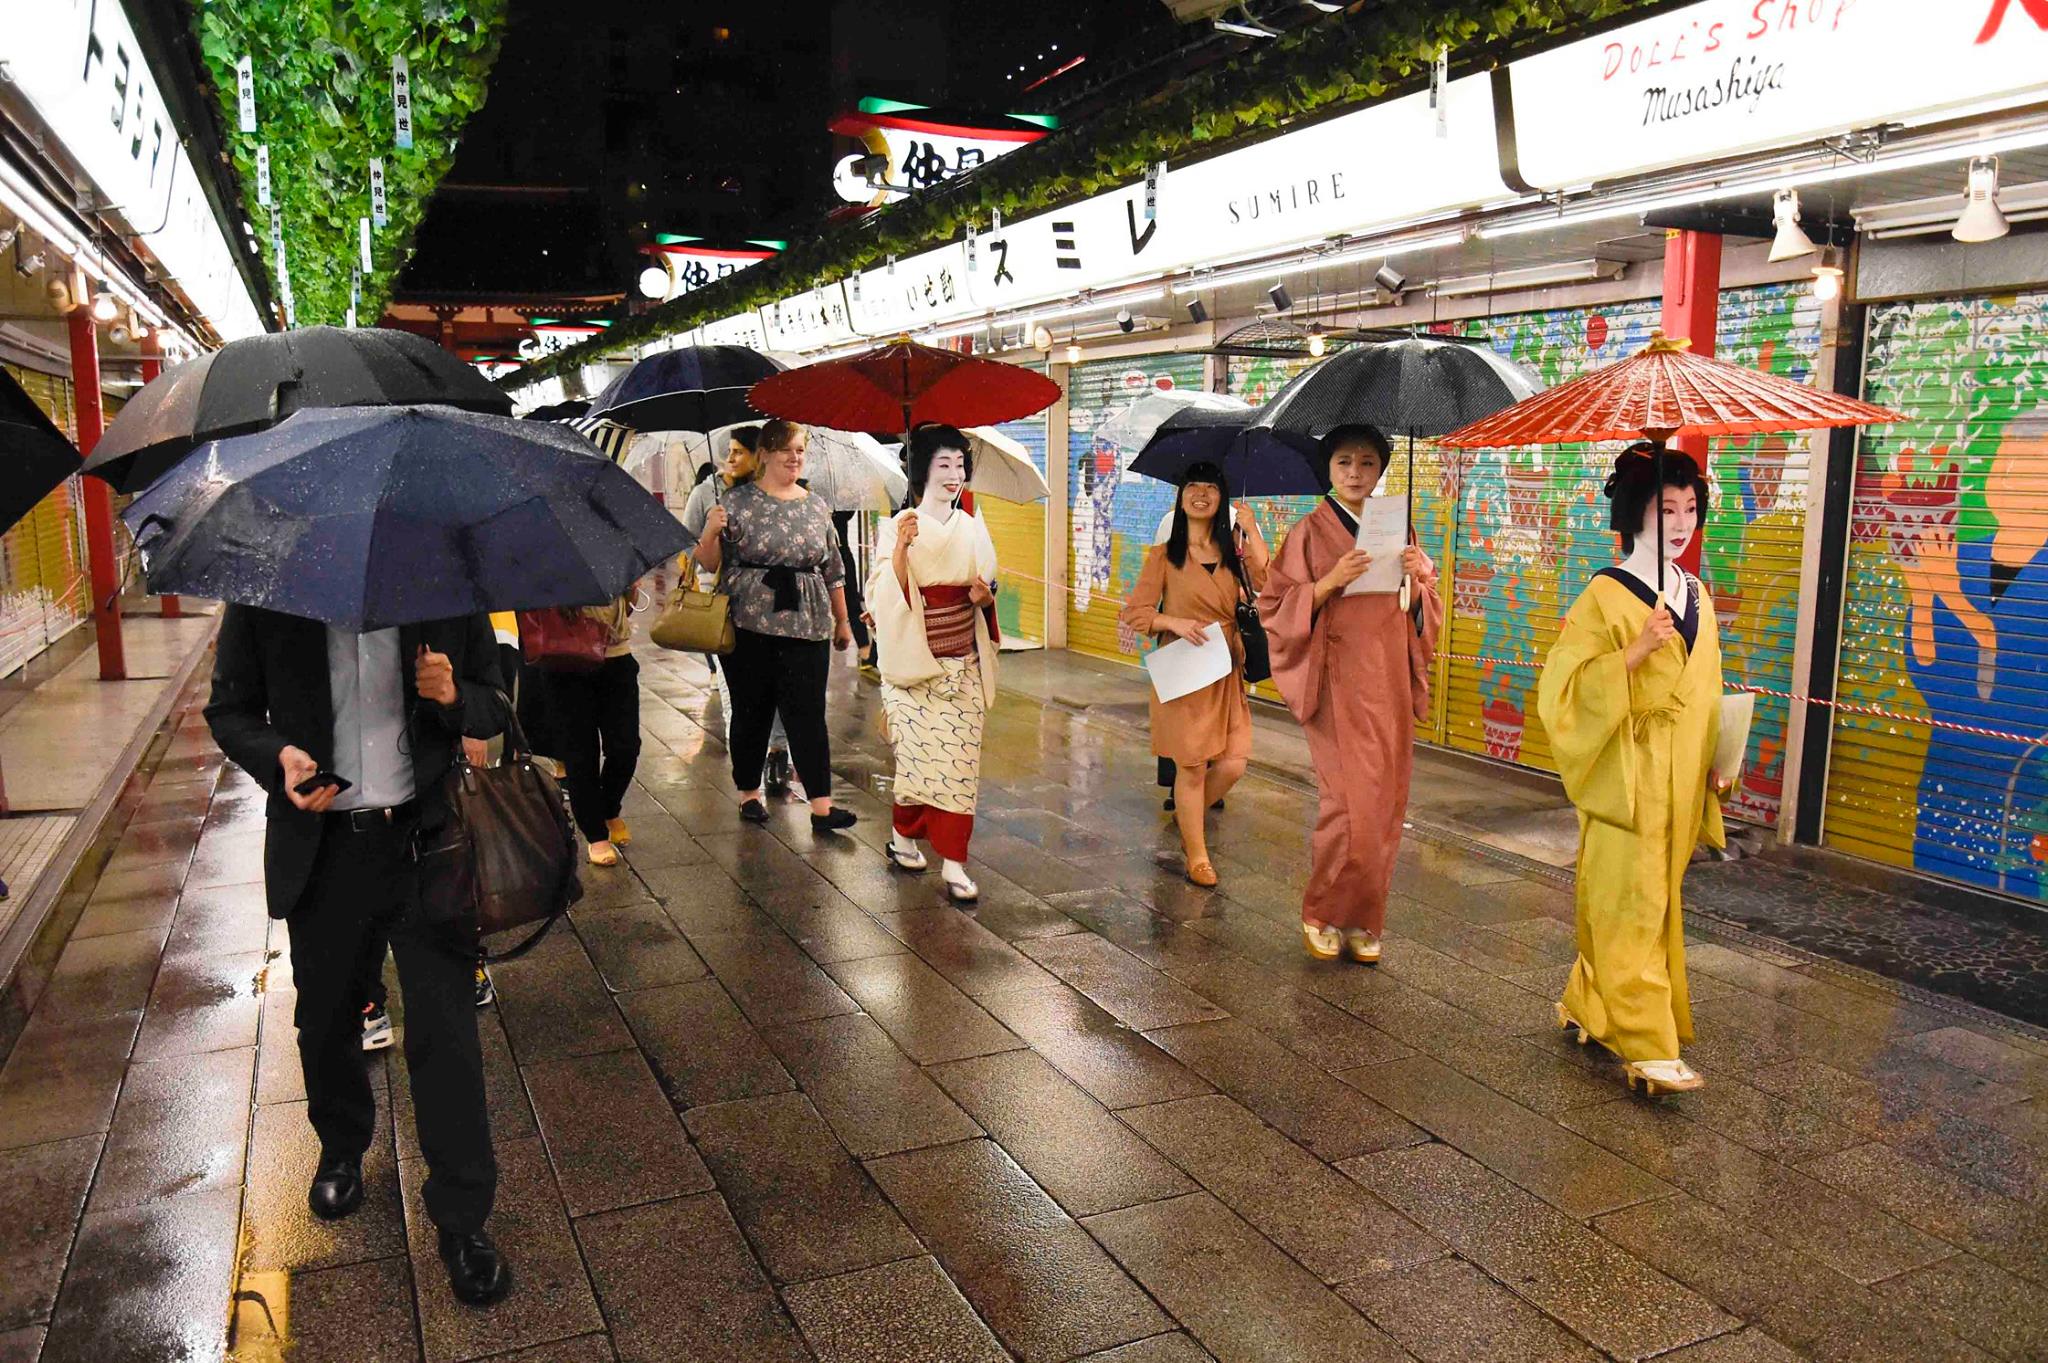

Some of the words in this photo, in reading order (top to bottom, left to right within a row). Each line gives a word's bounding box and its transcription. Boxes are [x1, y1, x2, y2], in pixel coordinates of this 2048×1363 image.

[396, 71, 410, 132] 仲見世
[373, 170, 384, 214] 仲見世
[1229, 172, 1345, 225] SUMIRE
[990, 199, 1157, 286] スミレ
